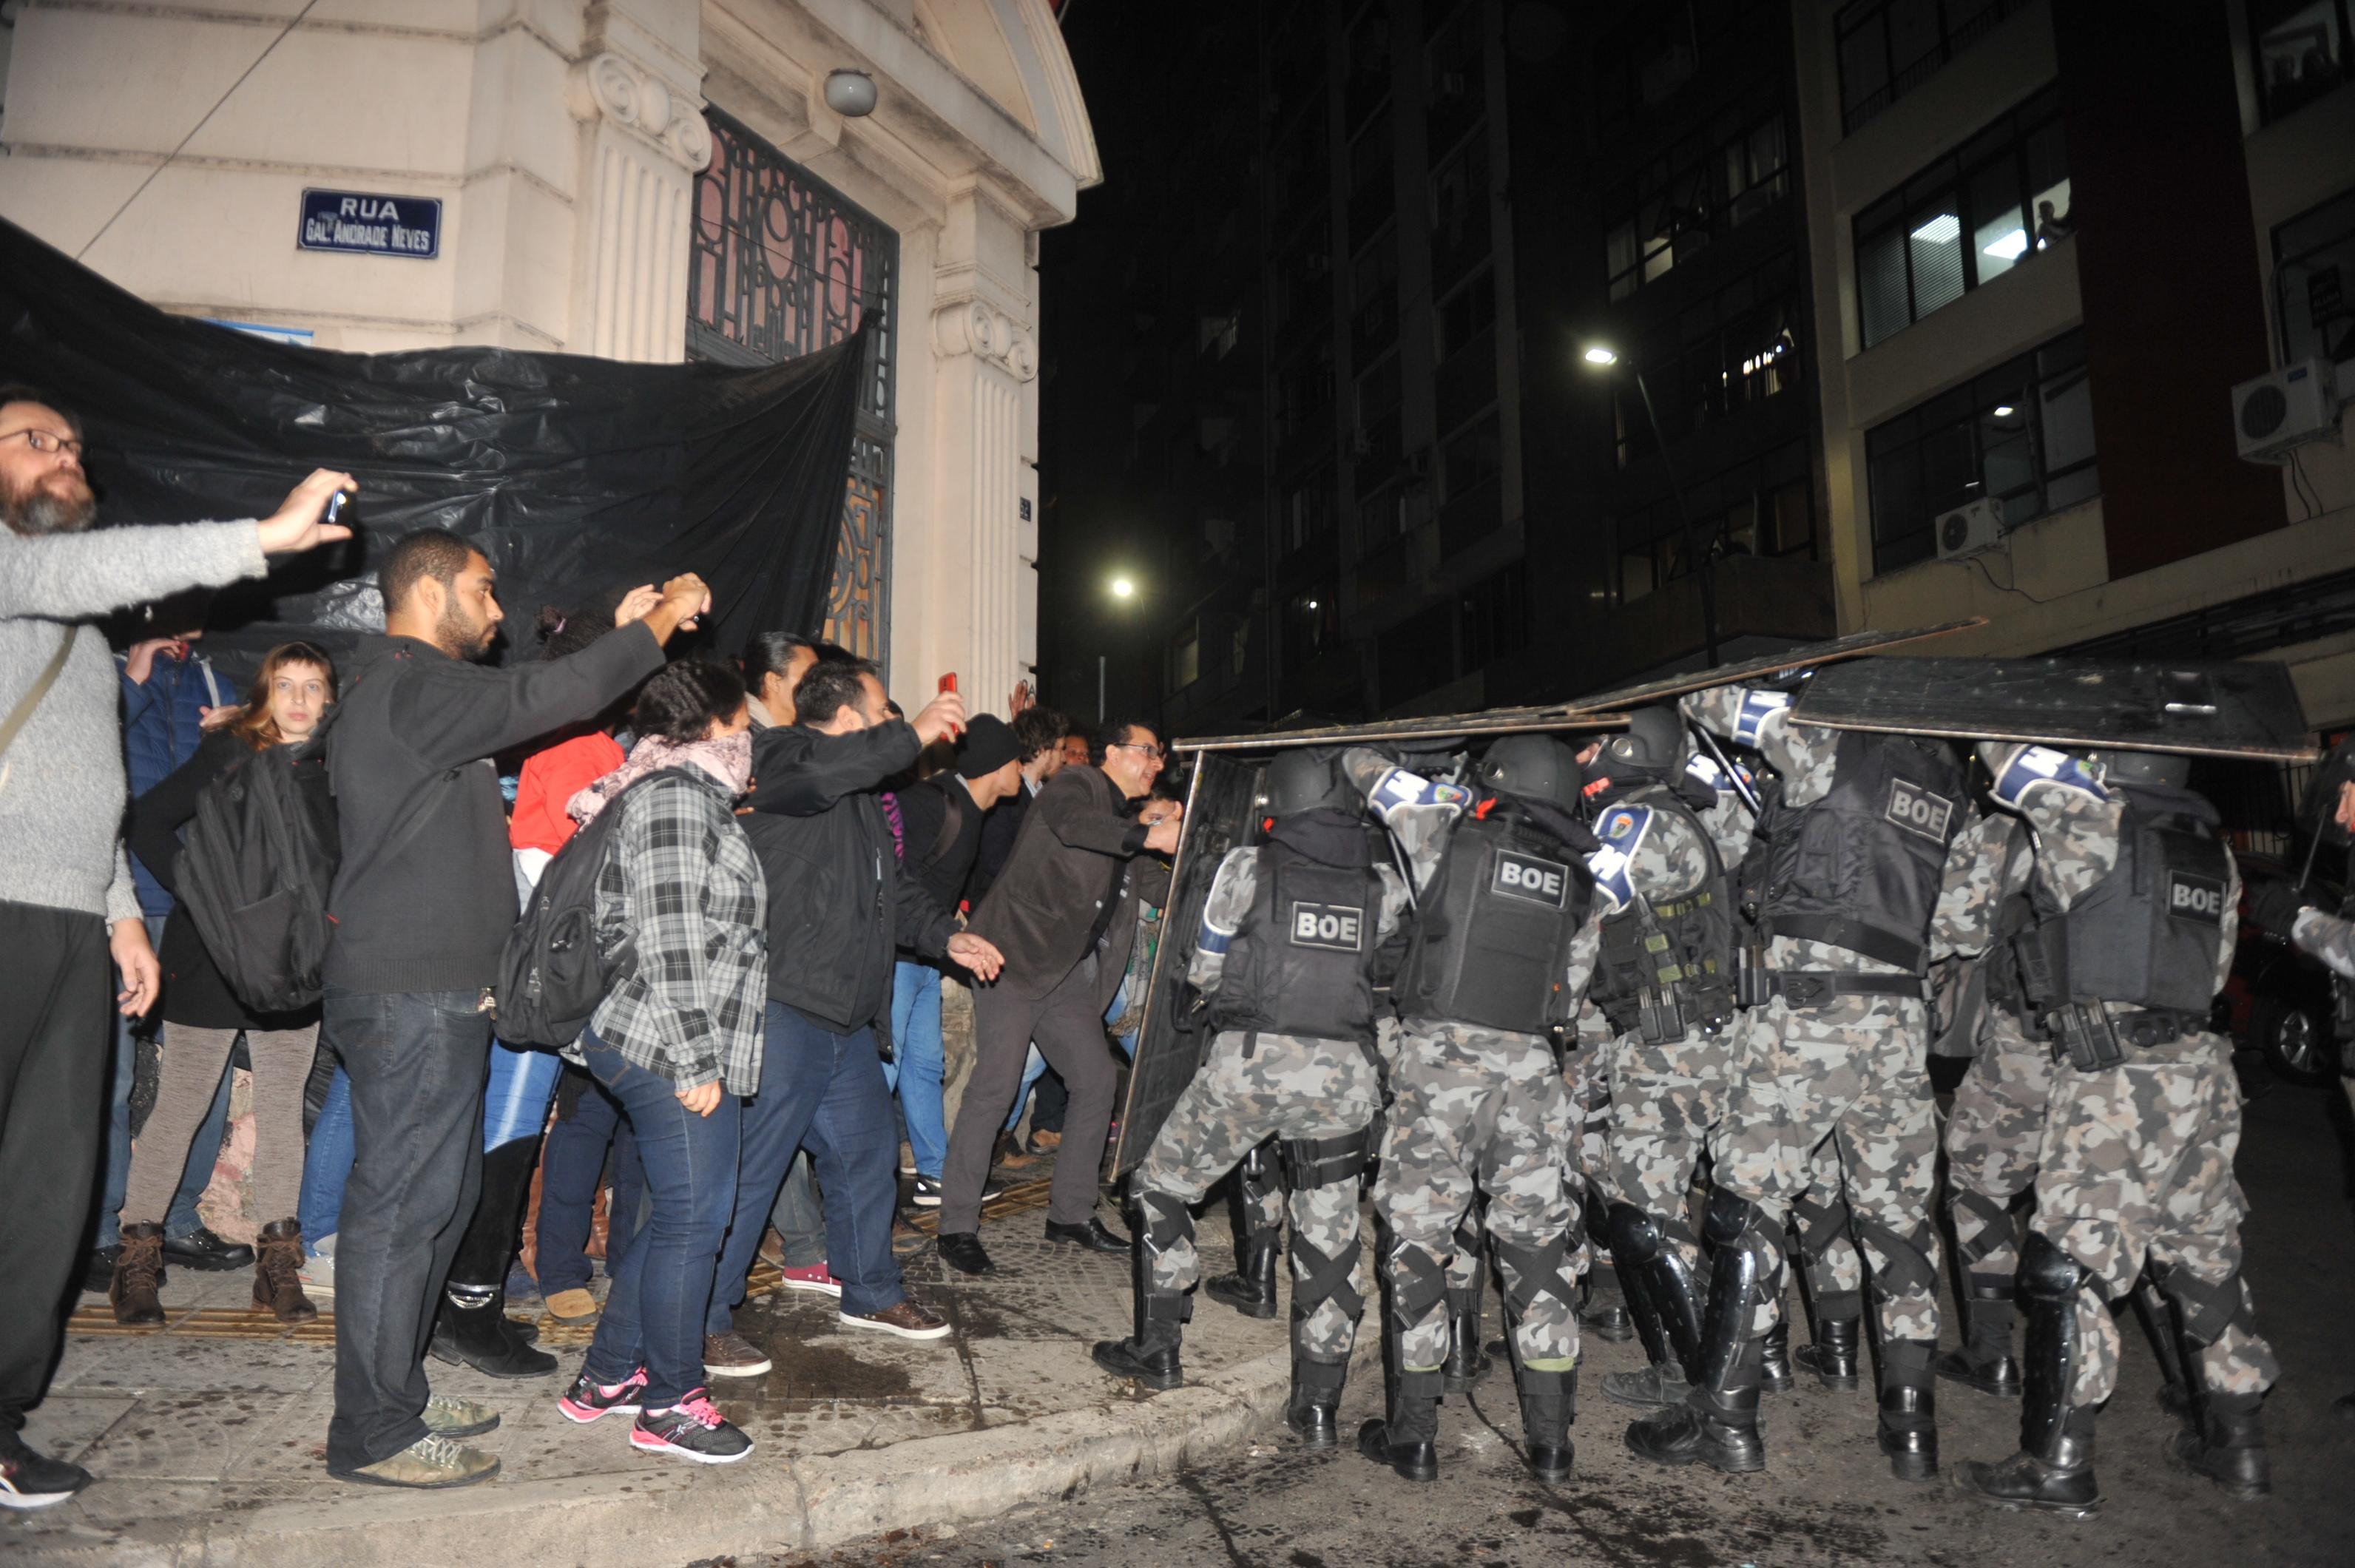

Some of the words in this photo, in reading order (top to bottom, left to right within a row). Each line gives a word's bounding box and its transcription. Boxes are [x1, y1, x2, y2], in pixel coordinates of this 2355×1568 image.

[340, 197, 399, 220] RUA
[334, 220, 388, 246] ANDRADE
[391, 223, 430, 251] NEVES
[1891, 789, 1946, 834] BOE
[1501, 861, 1561, 896] BOE
[2172, 882, 2220, 915] BOE
[1297, 911, 1357, 942] BOE
